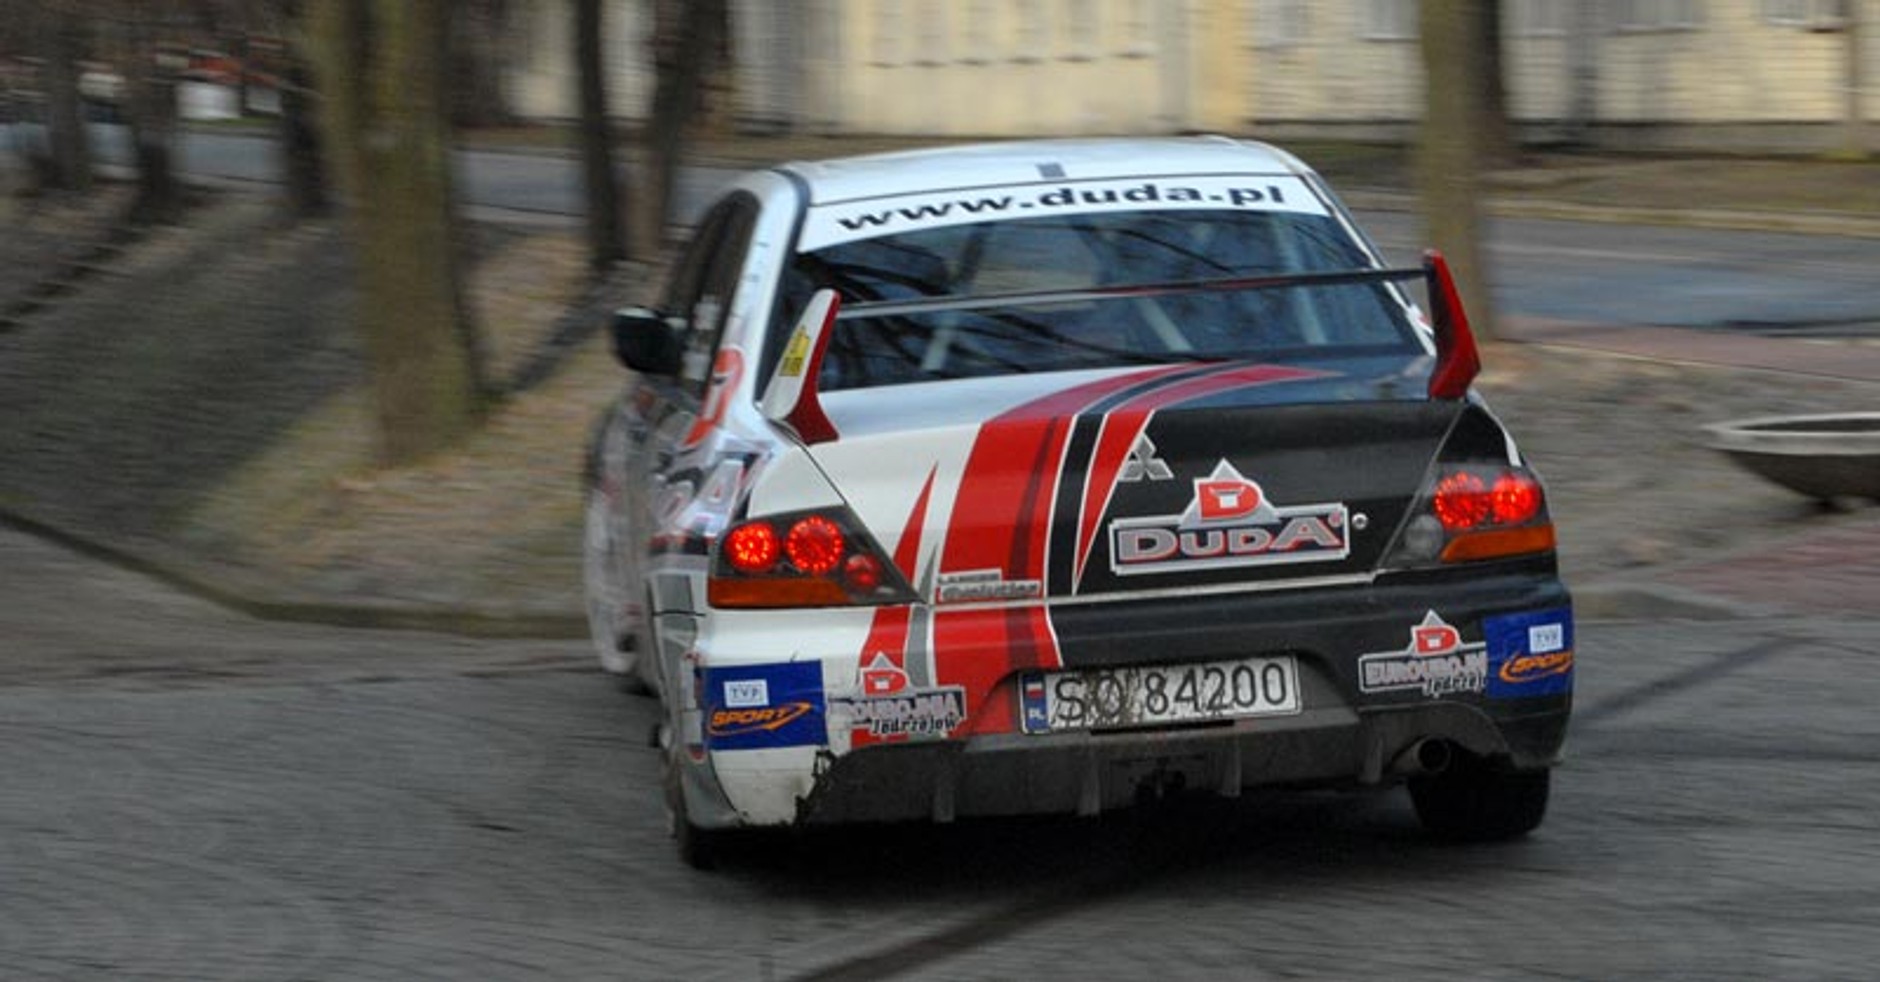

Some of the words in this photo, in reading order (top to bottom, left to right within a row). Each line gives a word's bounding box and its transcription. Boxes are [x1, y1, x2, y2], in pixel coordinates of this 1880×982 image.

[838, 183, 1285, 231] www.duda.pl
[1117, 516, 1342, 563] DUDA
[729, 684, 762, 699] TVP
[1144, 661, 1288, 716] 84200
[712, 708, 788, 727] SPORT
[1028, 707, 1045, 720] PL
